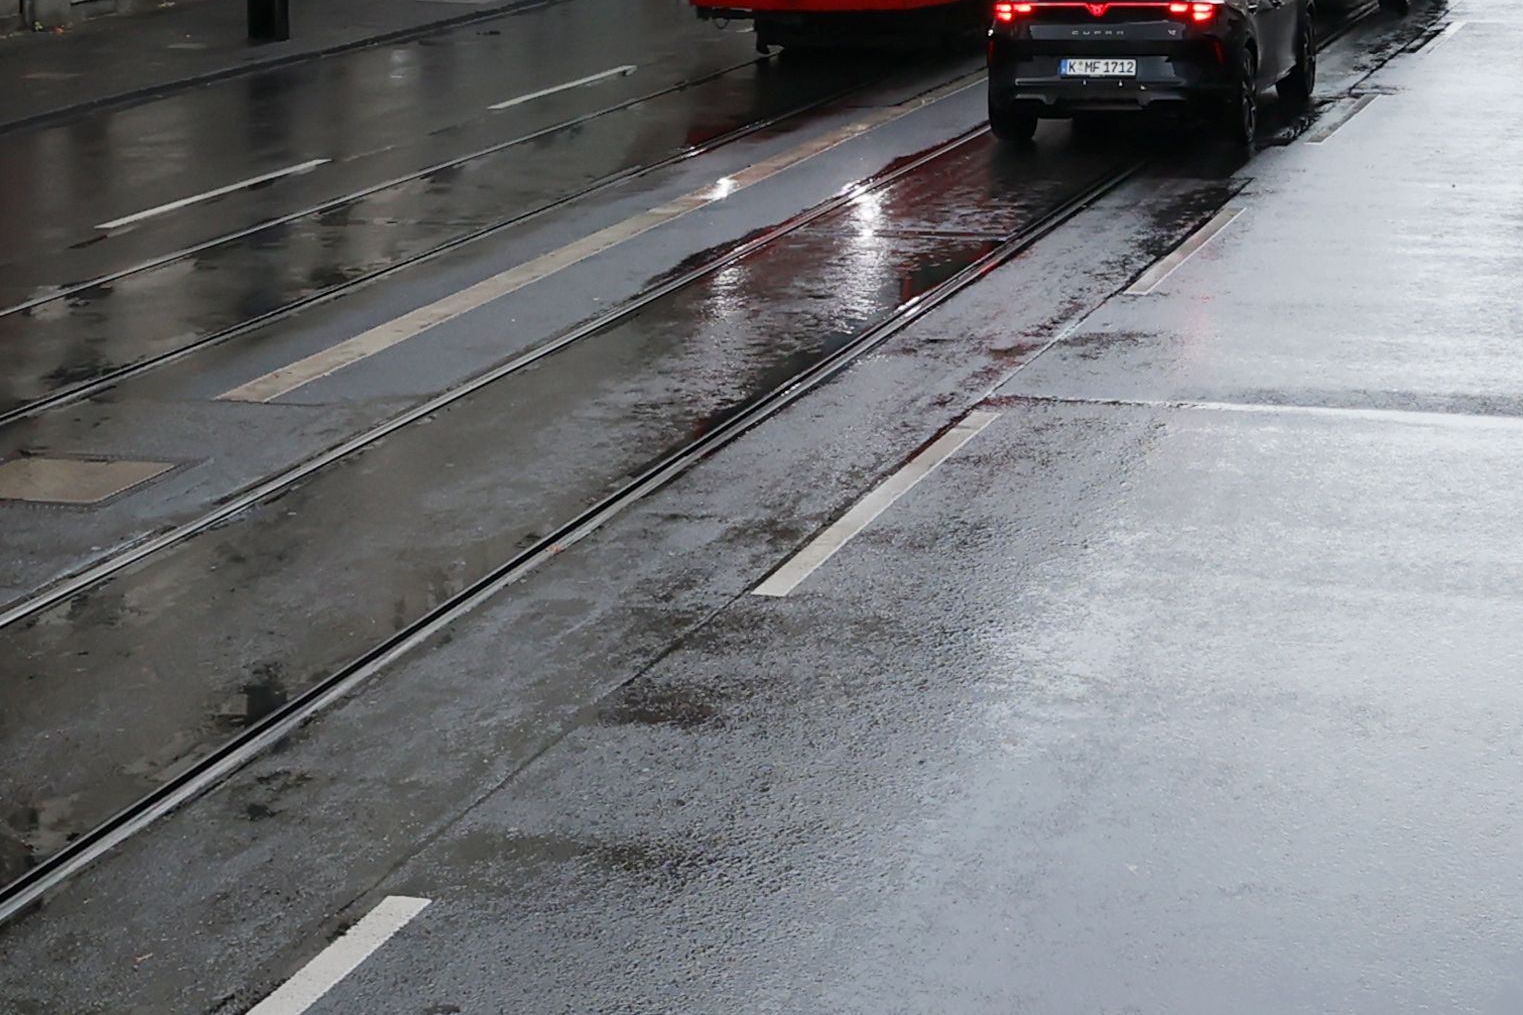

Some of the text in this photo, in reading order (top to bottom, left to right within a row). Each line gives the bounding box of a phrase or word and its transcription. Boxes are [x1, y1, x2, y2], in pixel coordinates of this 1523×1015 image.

[1068, 61, 1134, 74] K MF 1712
